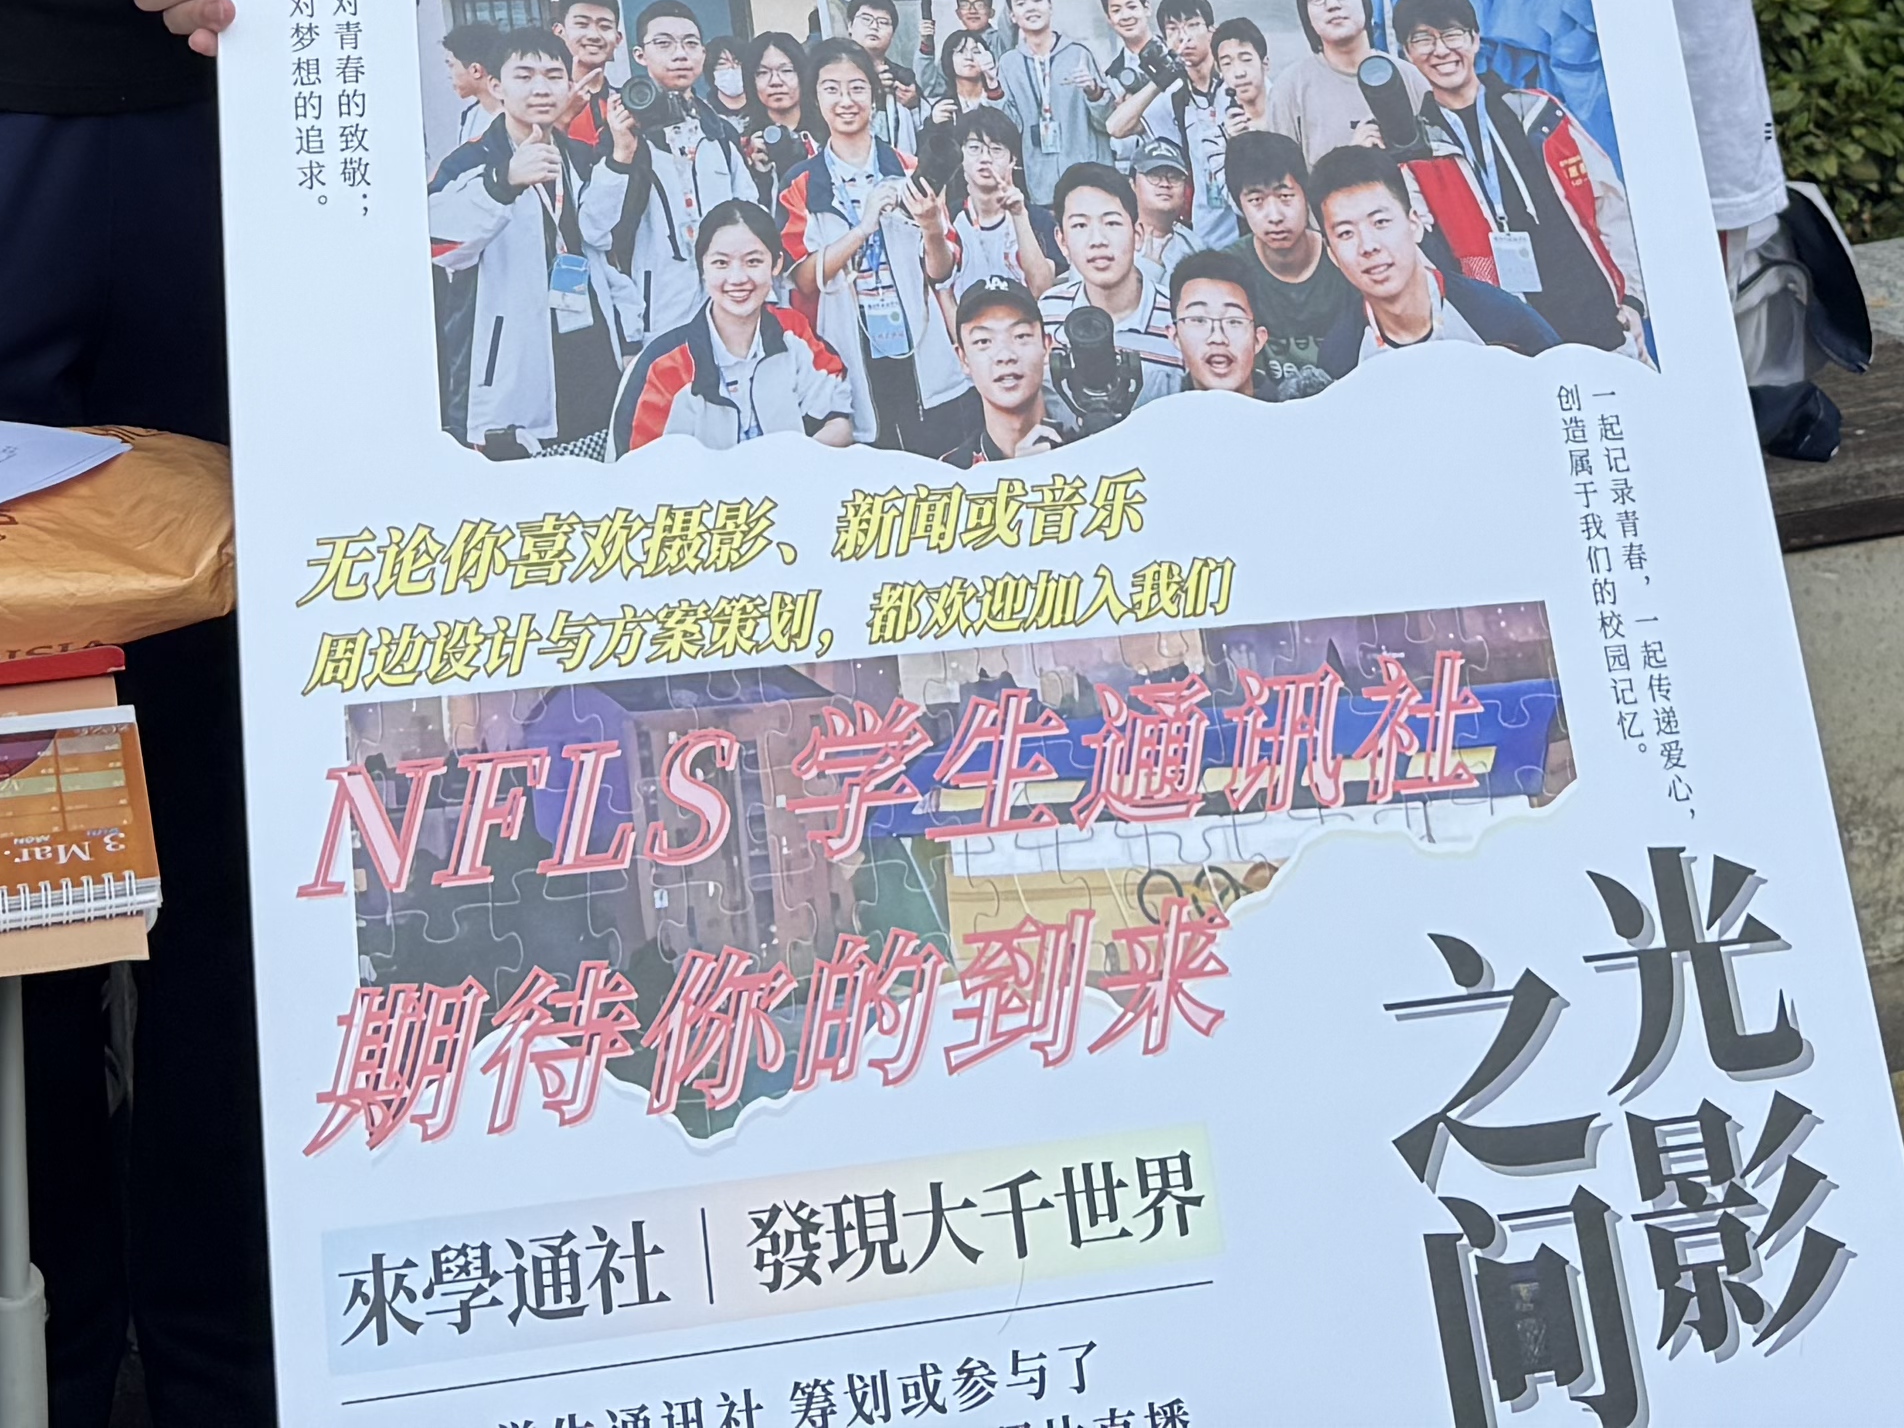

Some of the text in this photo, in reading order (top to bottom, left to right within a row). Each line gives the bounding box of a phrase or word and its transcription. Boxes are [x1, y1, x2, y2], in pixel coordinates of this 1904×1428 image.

[297, 466, 1149, 607] 无论你喜欢摄影、新闻或音乐
[301, 552, 1234, 696] 周边设计与方案策划，都欢迎加入我们
[1556, 384, 1647, 755] 创造属于我们的校园记忆。
[1591, 388, 1696, 820] 一起记录青春，一起传递爱心，
[2, 831, 127, 865] 3 Mar.
[296, 724, 743, 901] NFLS
[303, 896, 1234, 1158] 期待你的到来
[1582, 845, 1858, 1362] 光影
[337, 1147, 1207, 1347] 來學通社 發現大千世界
[1382, 932, 1650, 1428] 之间
[788, 1340, 1098, 1428] 筹划或参与了
